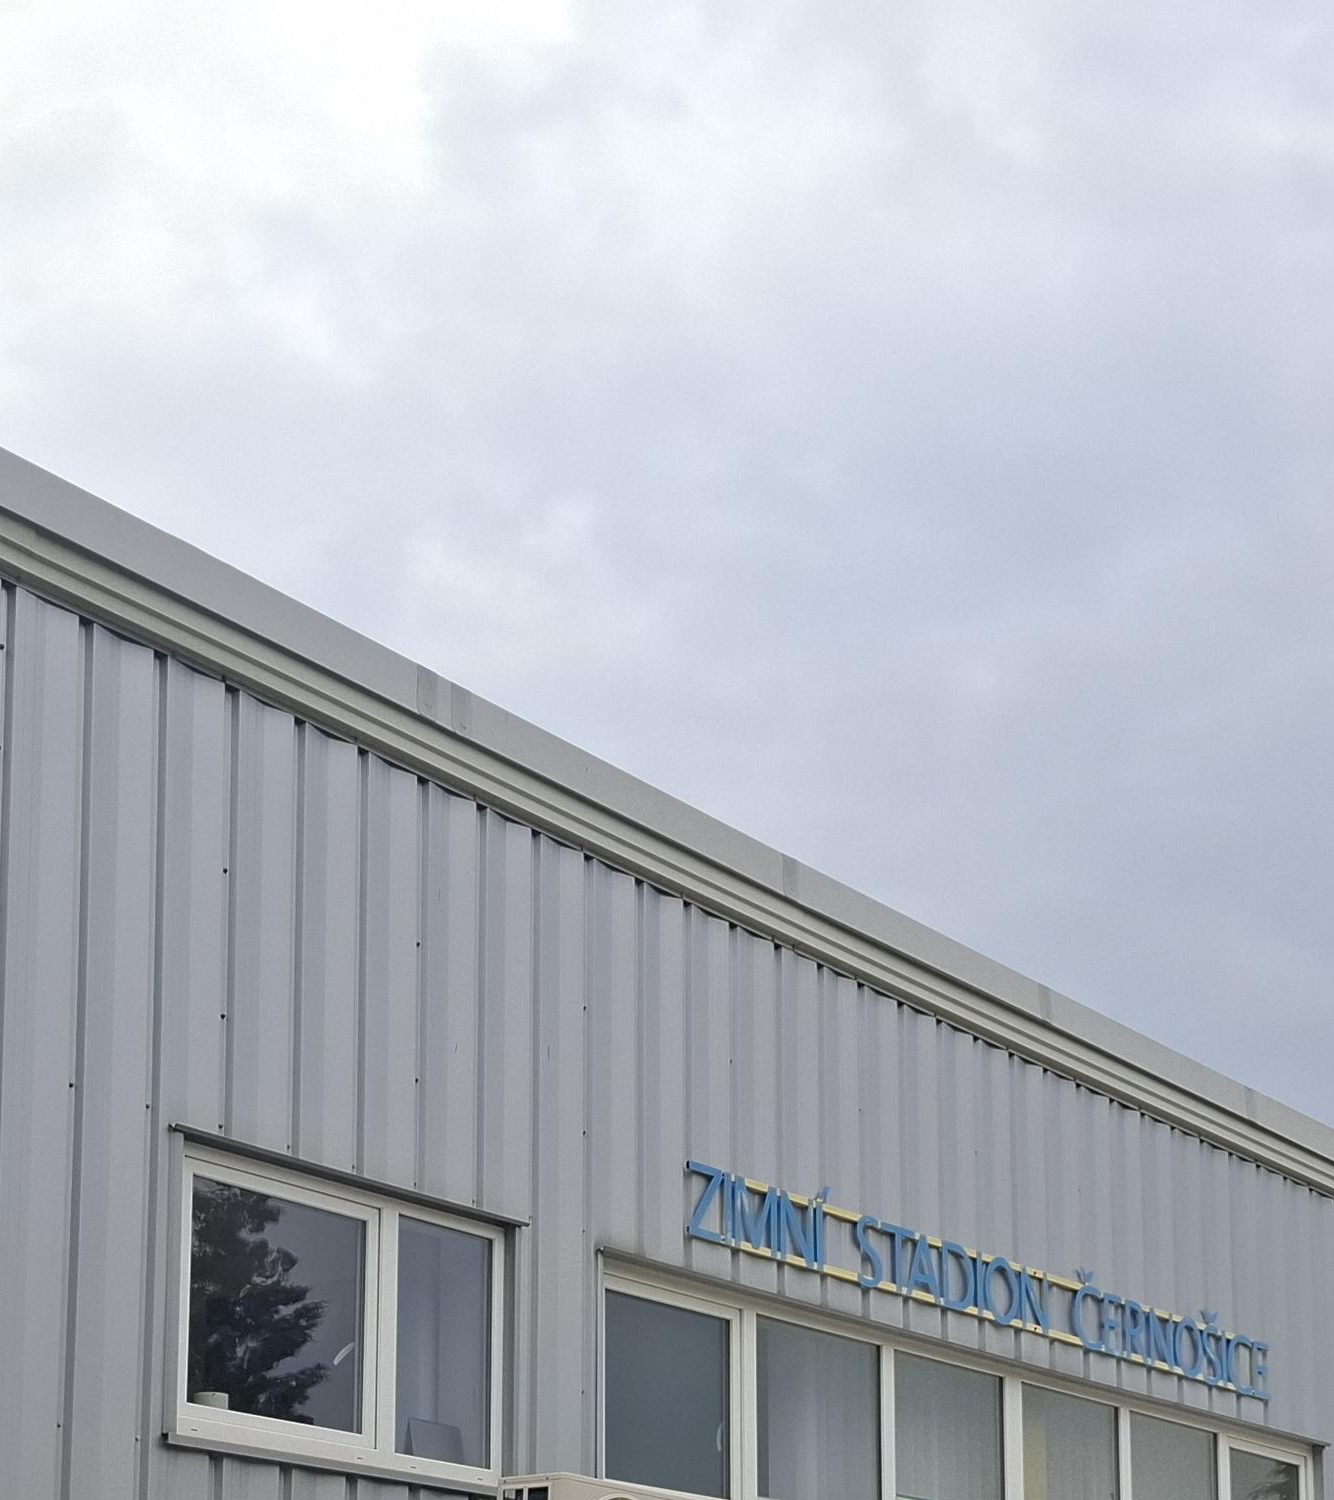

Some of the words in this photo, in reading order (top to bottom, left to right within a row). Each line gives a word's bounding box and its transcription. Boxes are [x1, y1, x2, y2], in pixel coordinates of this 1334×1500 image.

[685, 1160, 831, 1274] ZIMNÍ
[853, 1215, 1050, 1335] STADION
[1071, 1268, 1270, 1400] ČERNOŠICE
